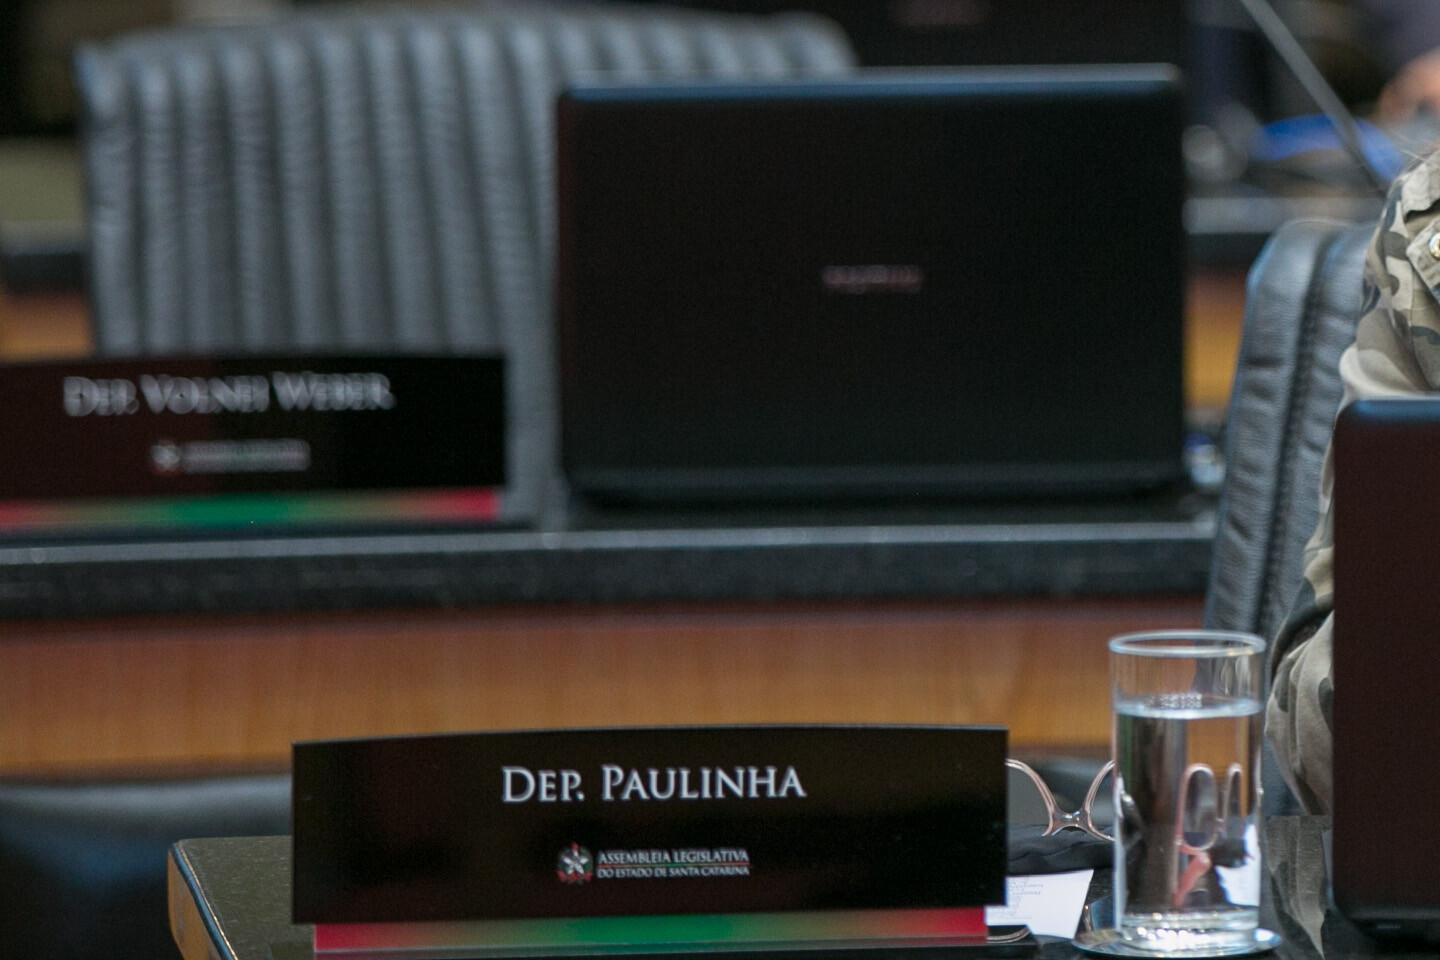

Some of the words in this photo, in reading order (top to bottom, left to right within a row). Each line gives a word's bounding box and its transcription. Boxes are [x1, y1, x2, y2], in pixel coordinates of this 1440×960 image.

[501, 766, 585, 802] DEP.
[601, 765, 807, 800] PAULINHA
[598, 850, 672, 864] ASSEMBLEIA
[673, 847, 749, 863] LEGISLATIVA
[597, 868, 614, 878] DO
[615, 867, 652, 878] ESTADO
[654, 867, 668, 877] DE
[669, 866, 700, 877] SANTA
[701, 866, 749, 876] CATARINA
